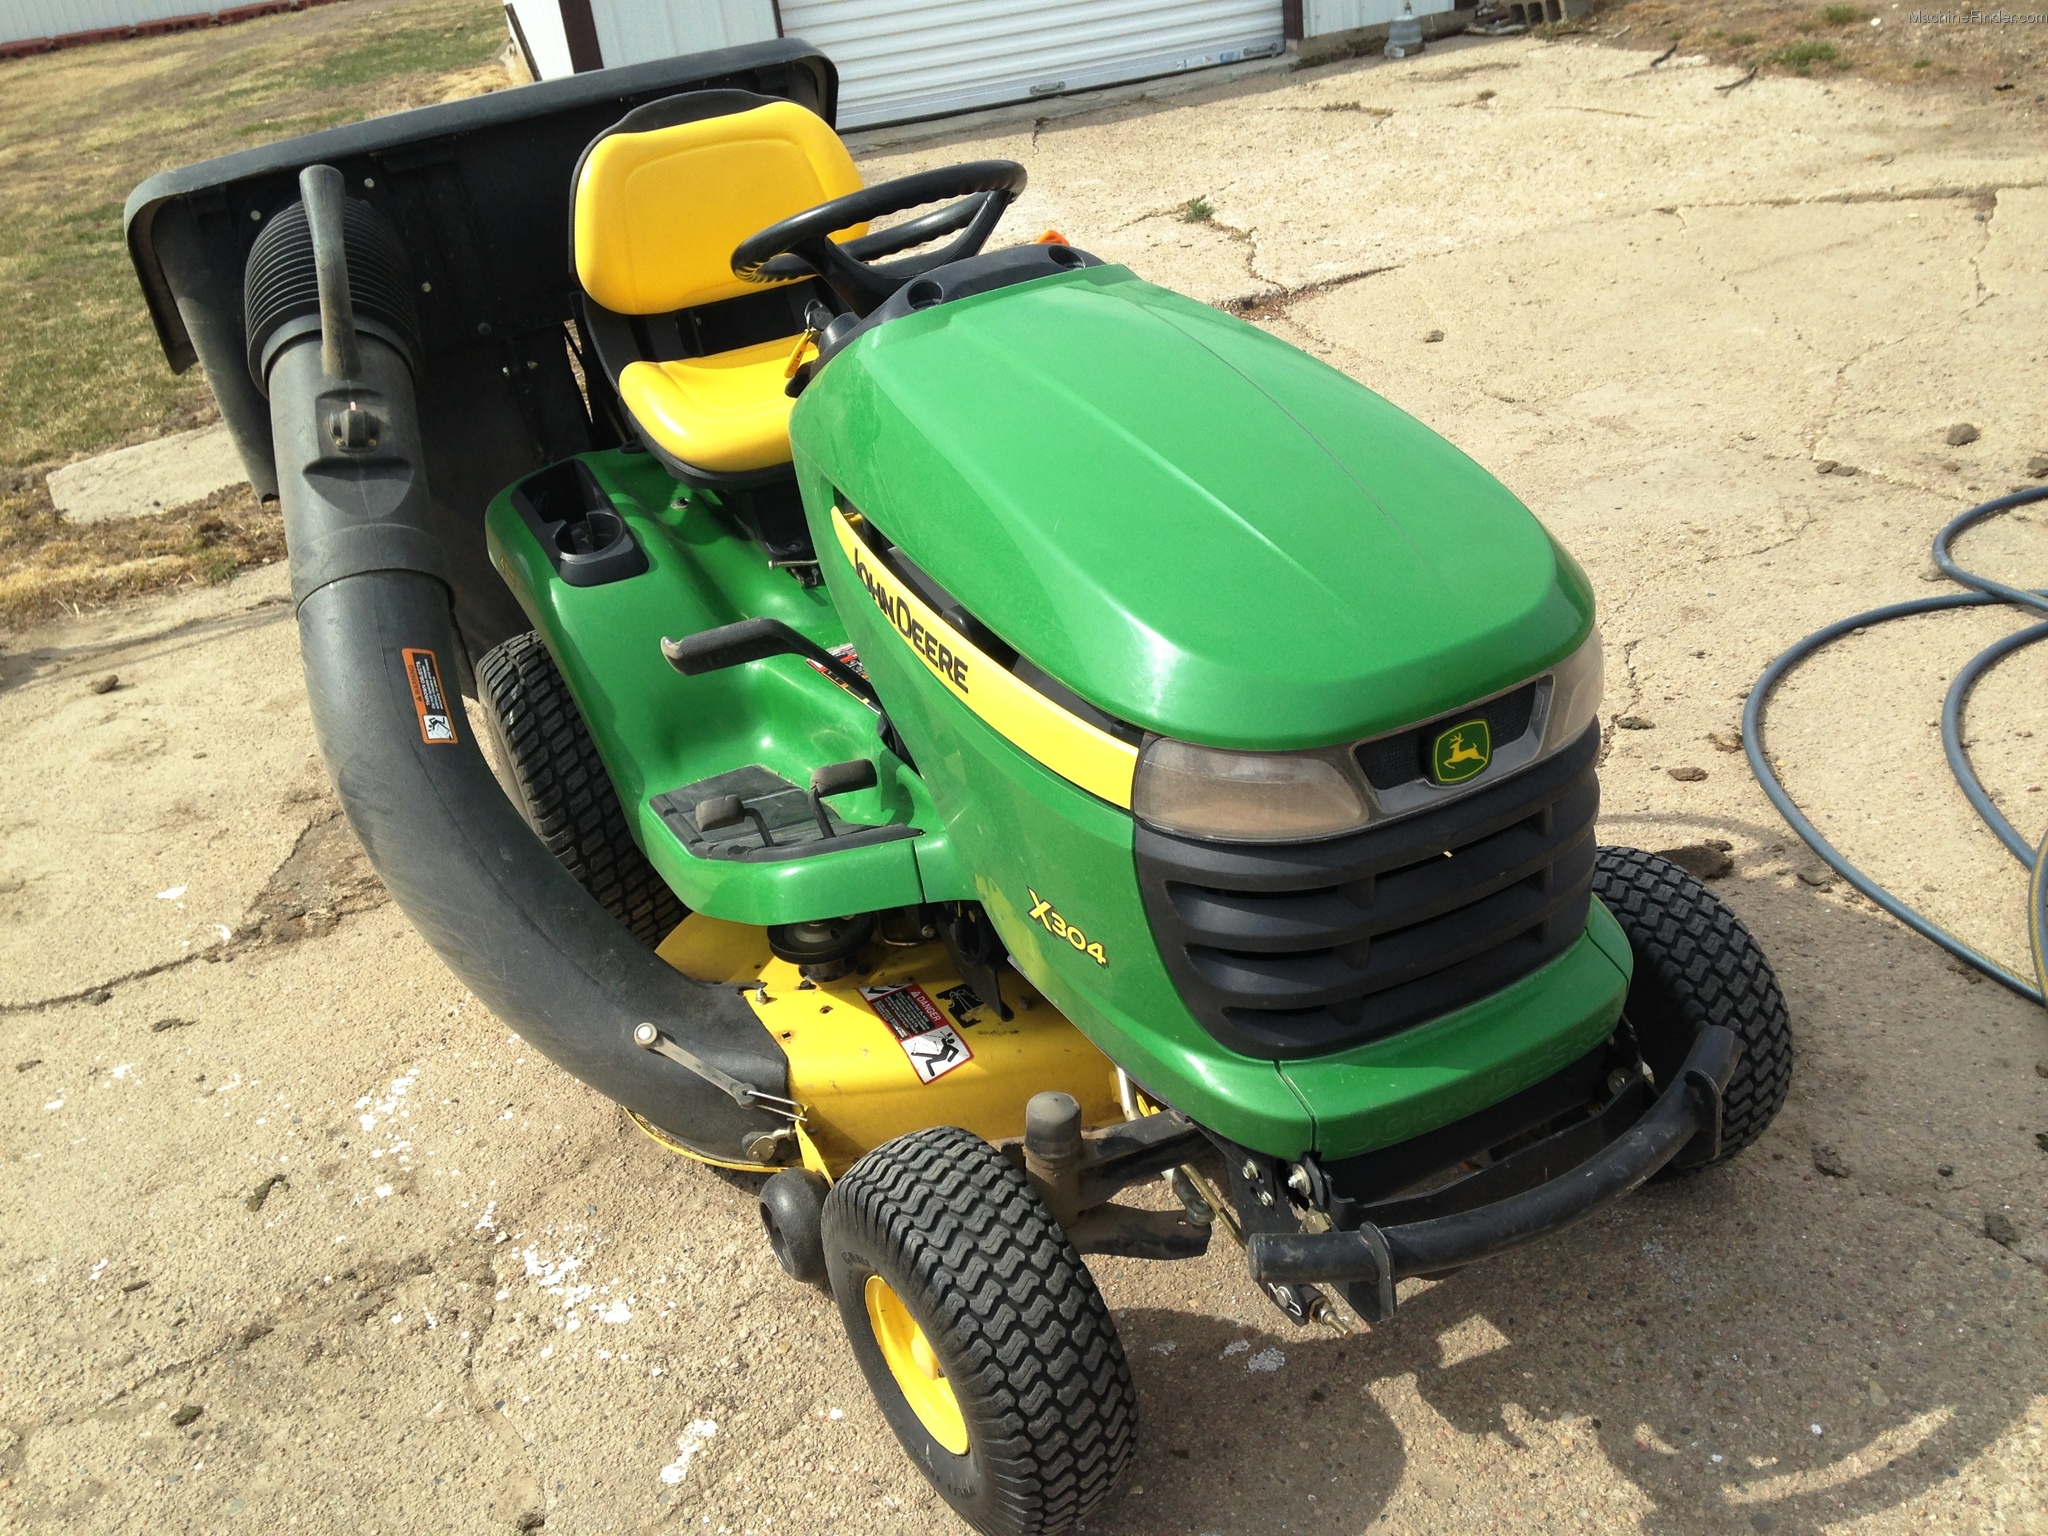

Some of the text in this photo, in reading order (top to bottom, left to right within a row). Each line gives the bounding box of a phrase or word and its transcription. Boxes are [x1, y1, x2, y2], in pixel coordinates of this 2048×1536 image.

[896, 596, 969, 694] DEERE
[407, 664, 420, 694] WARNING
[1026, 885, 1109, 969] X304
[915, 995, 942, 1021] DANGER
